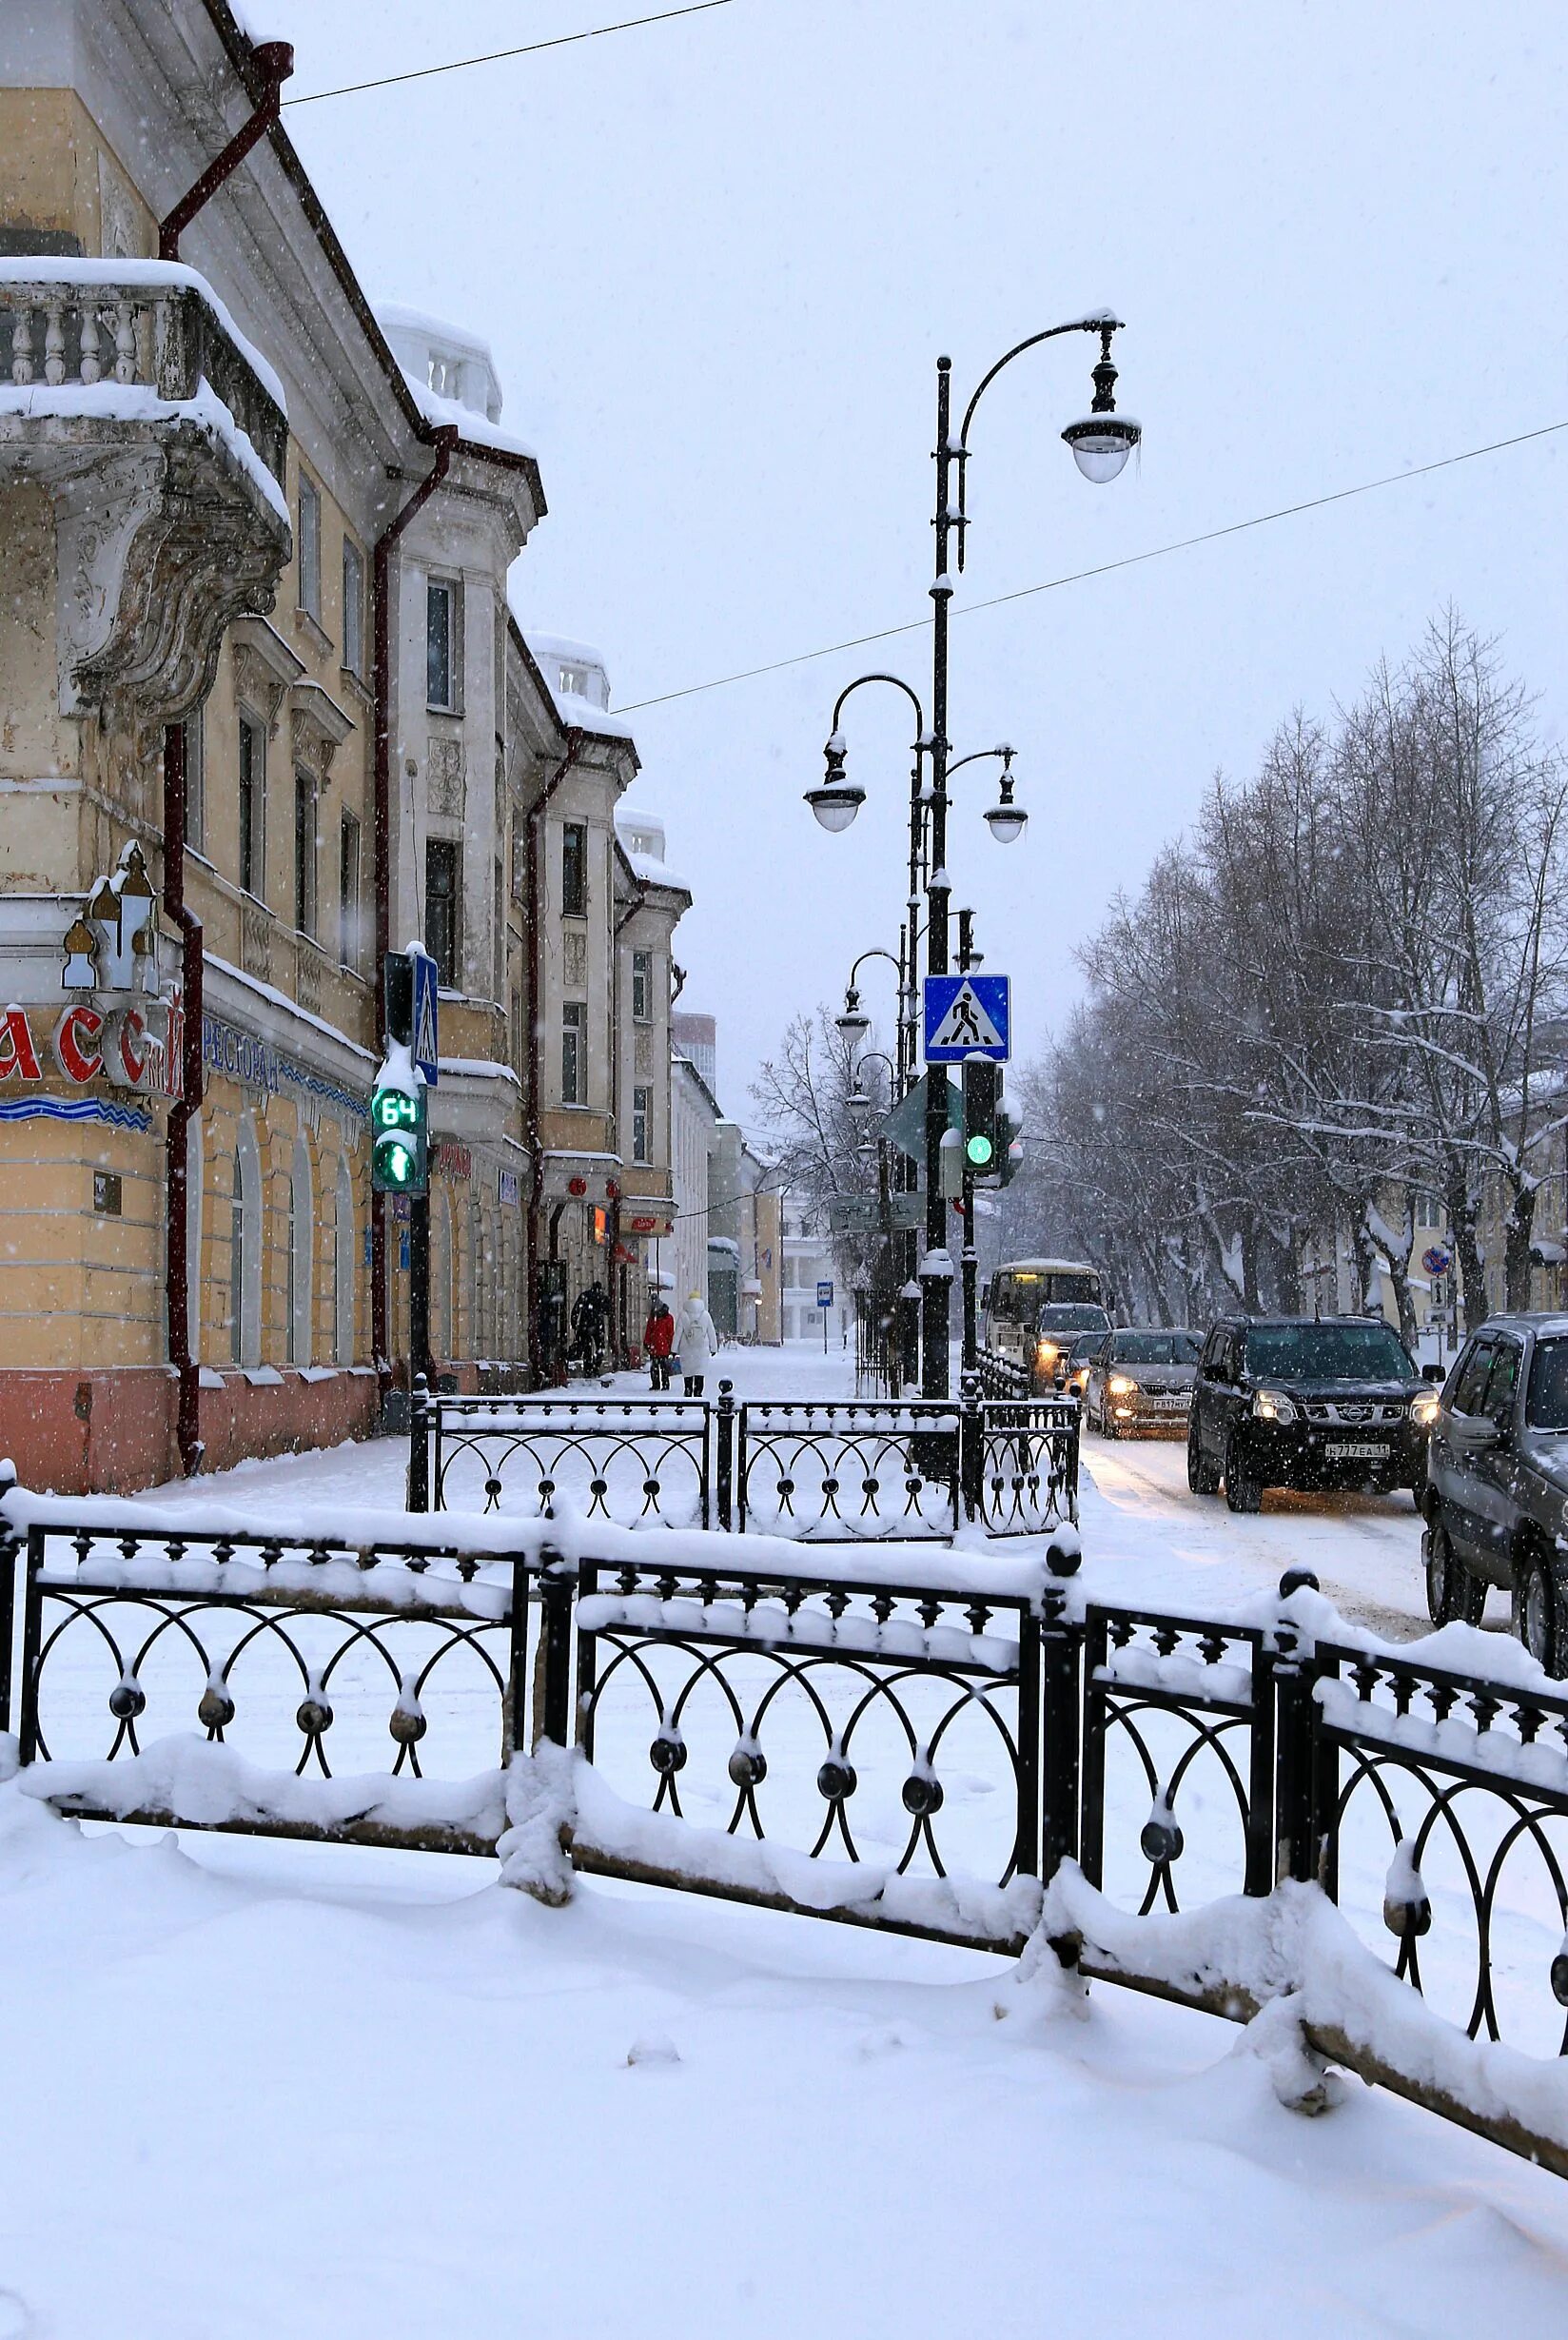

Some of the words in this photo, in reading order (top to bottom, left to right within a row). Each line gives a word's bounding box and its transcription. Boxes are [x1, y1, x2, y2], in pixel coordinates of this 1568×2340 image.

[203, 1017, 280, 1092] РЕСТОРАН
[382, 1097, 416, 1125] 64
[1329, 1445, 1373, 1456] Н777ЕА
[1376, 1445, 1386, 1454] 11
